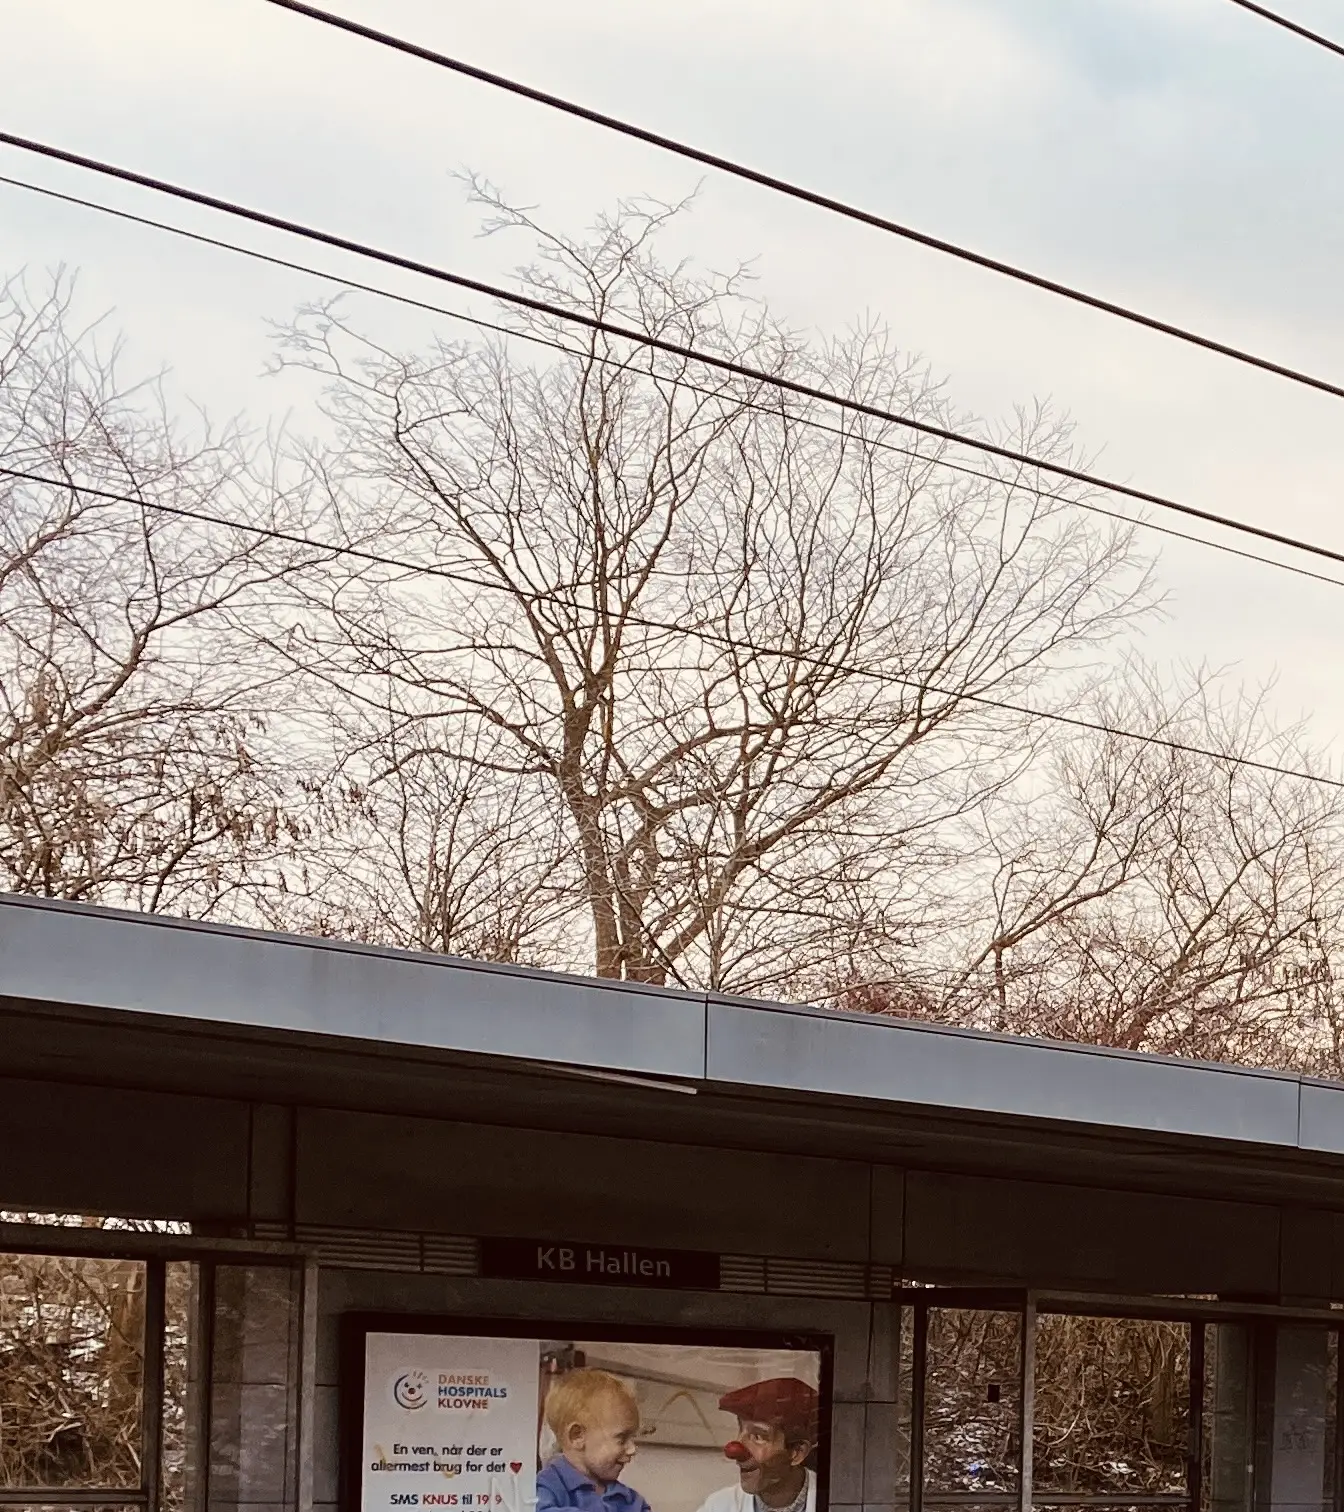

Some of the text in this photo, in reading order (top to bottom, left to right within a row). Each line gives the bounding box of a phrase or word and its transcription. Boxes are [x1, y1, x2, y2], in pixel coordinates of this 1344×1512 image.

[537, 1246, 671, 1277] KB Hallen
[438, 1374, 489, 1386] DANSKE
[438, 1386, 507, 1398] HOSPITALS
[437, 1398, 489, 1409] KLOVNE
[393, 1443, 408, 1455] En
[441, 1444, 463, 1455] når
[466, 1445, 487, 1456] der
[490, 1447, 503, 1456] er
[371, 1460, 506, 1474] allermest brug for det
[390, 1493, 503, 1505] SMS KNUS til 199
